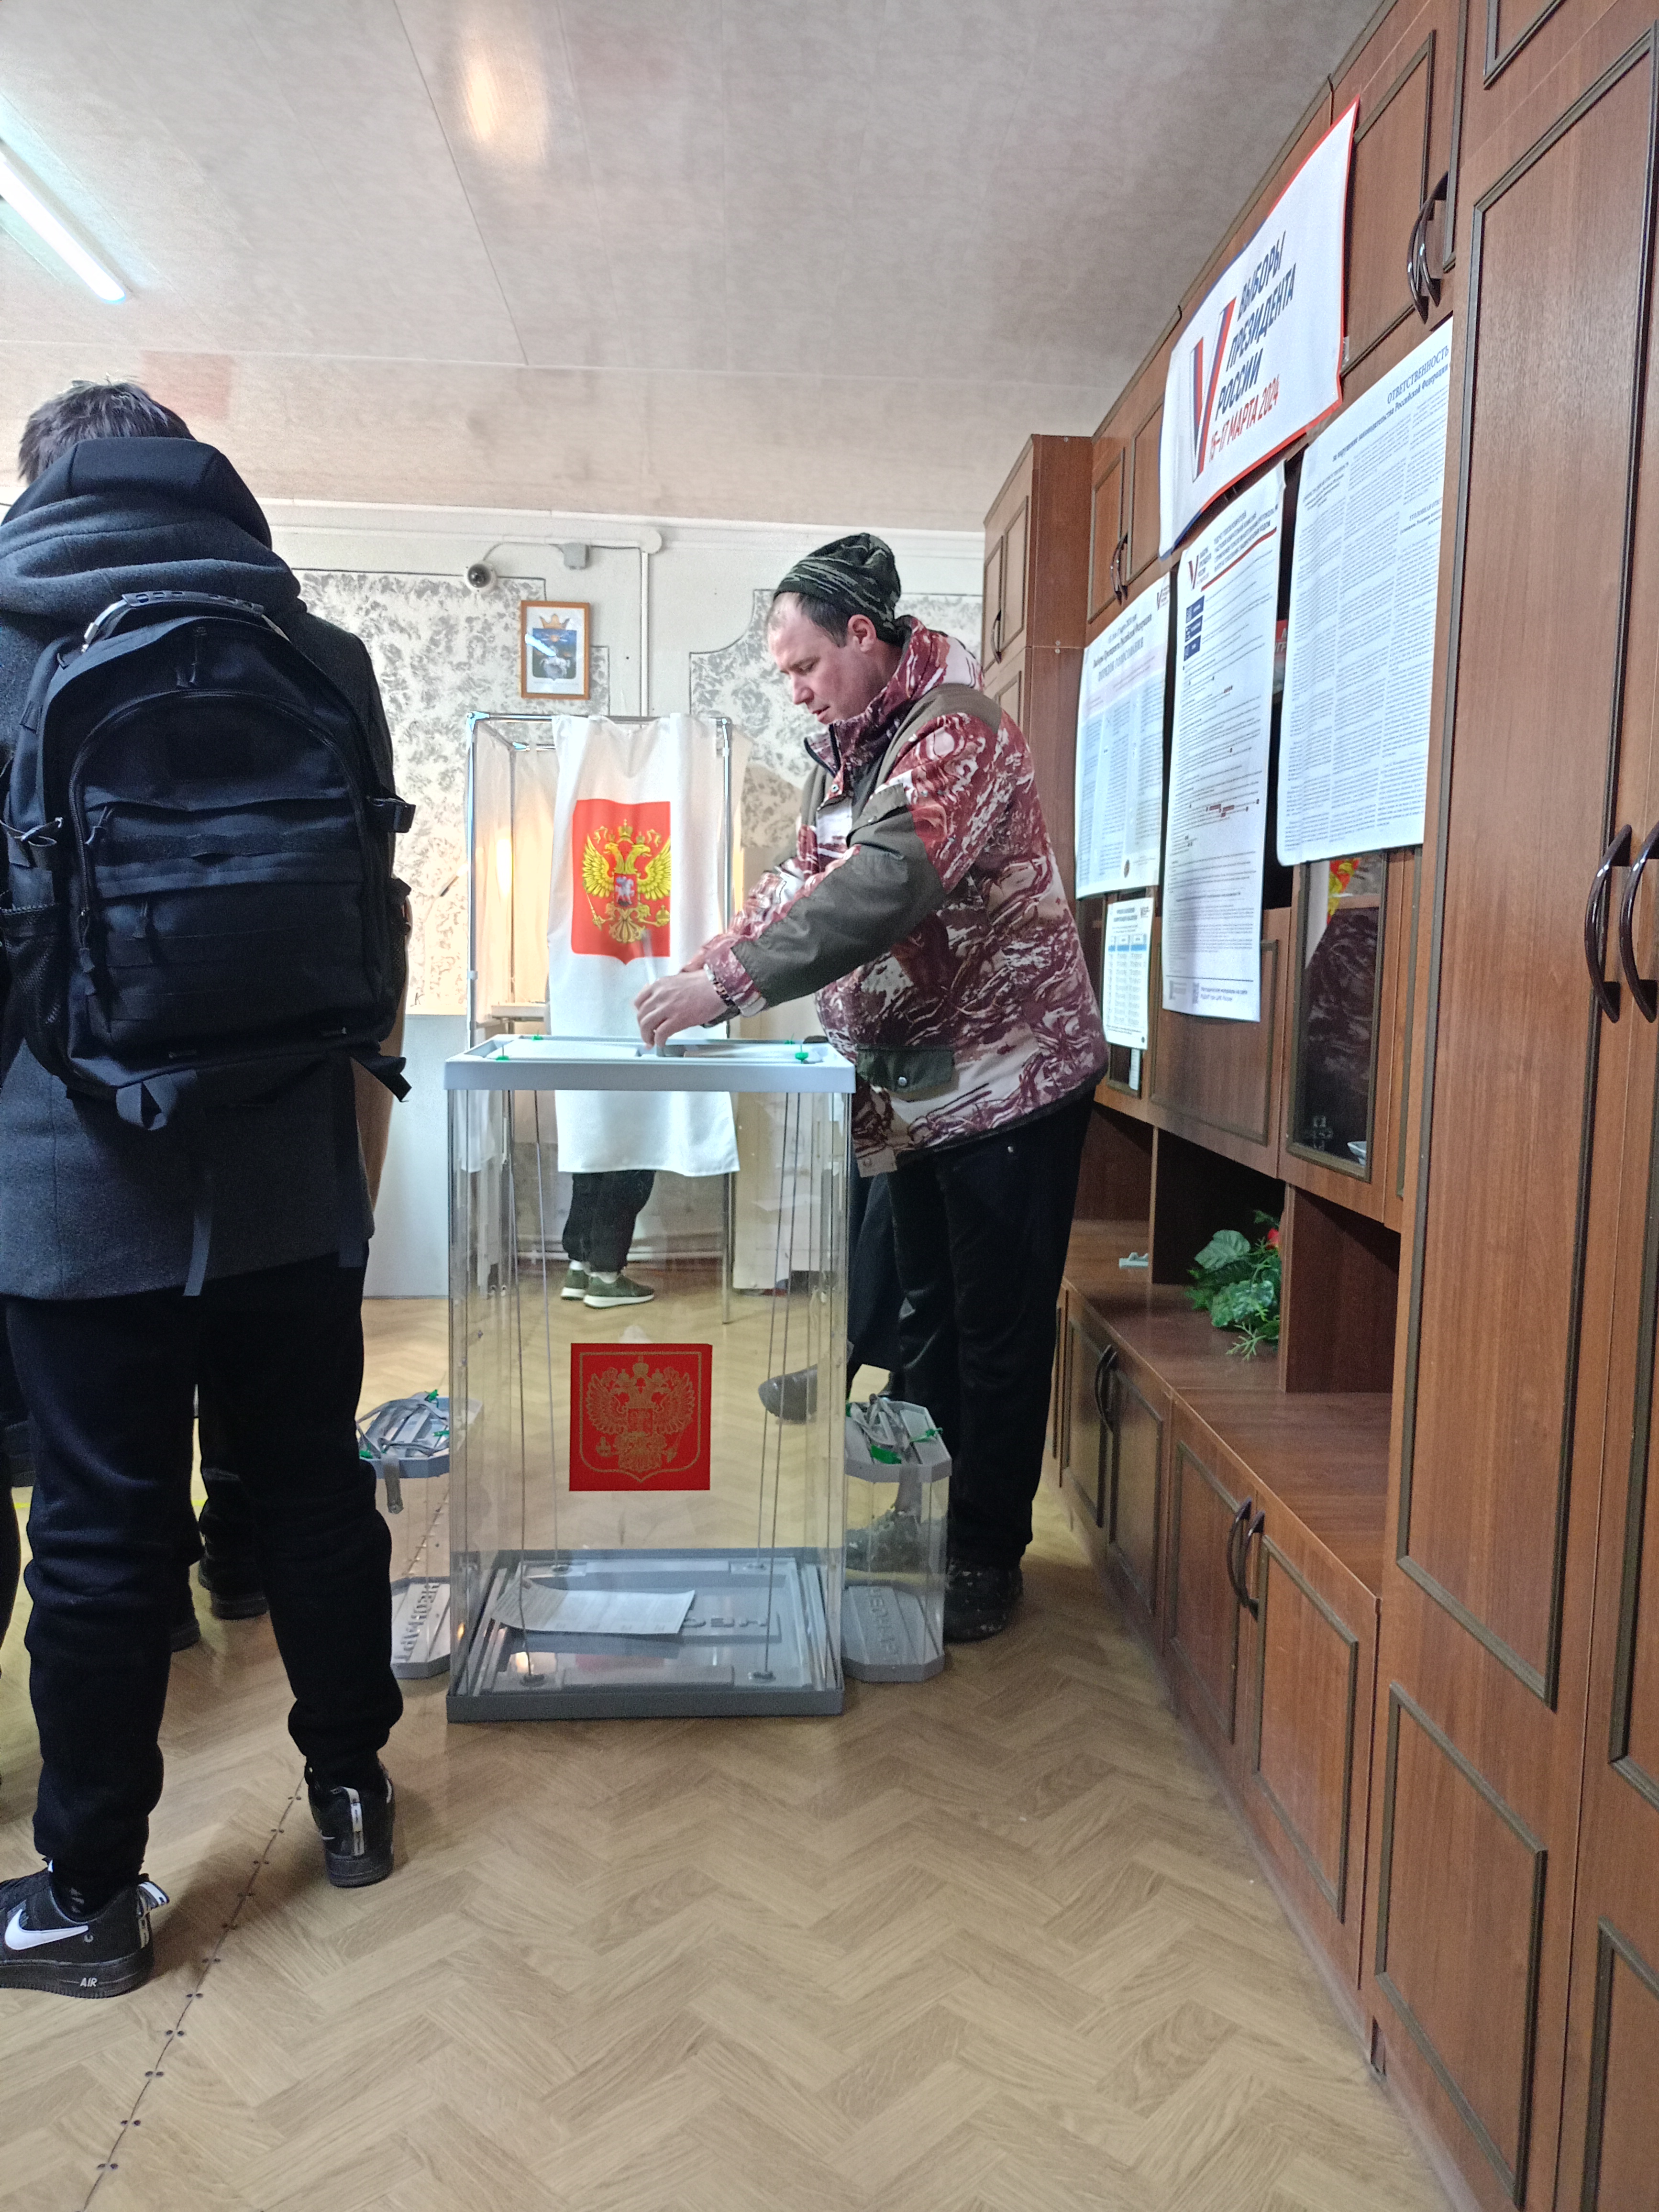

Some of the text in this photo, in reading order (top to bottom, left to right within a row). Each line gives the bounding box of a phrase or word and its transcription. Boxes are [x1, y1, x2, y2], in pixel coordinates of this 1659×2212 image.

[1238, 230, 1286, 321] ВЫБОРЫ
[1226, 263, 1296, 372] ПРЕЗИДЕНТА
[1215, 347, 1263, 421] РОССИИ
[1227, 395, 1259, 445] МАРТА
[1258, 374, 1279, 421] 2024
[1387, 345, 1449, 404] ОТВЕТСТВЕННОСТЬ
[80, 1977, 98, 1987] AIR
